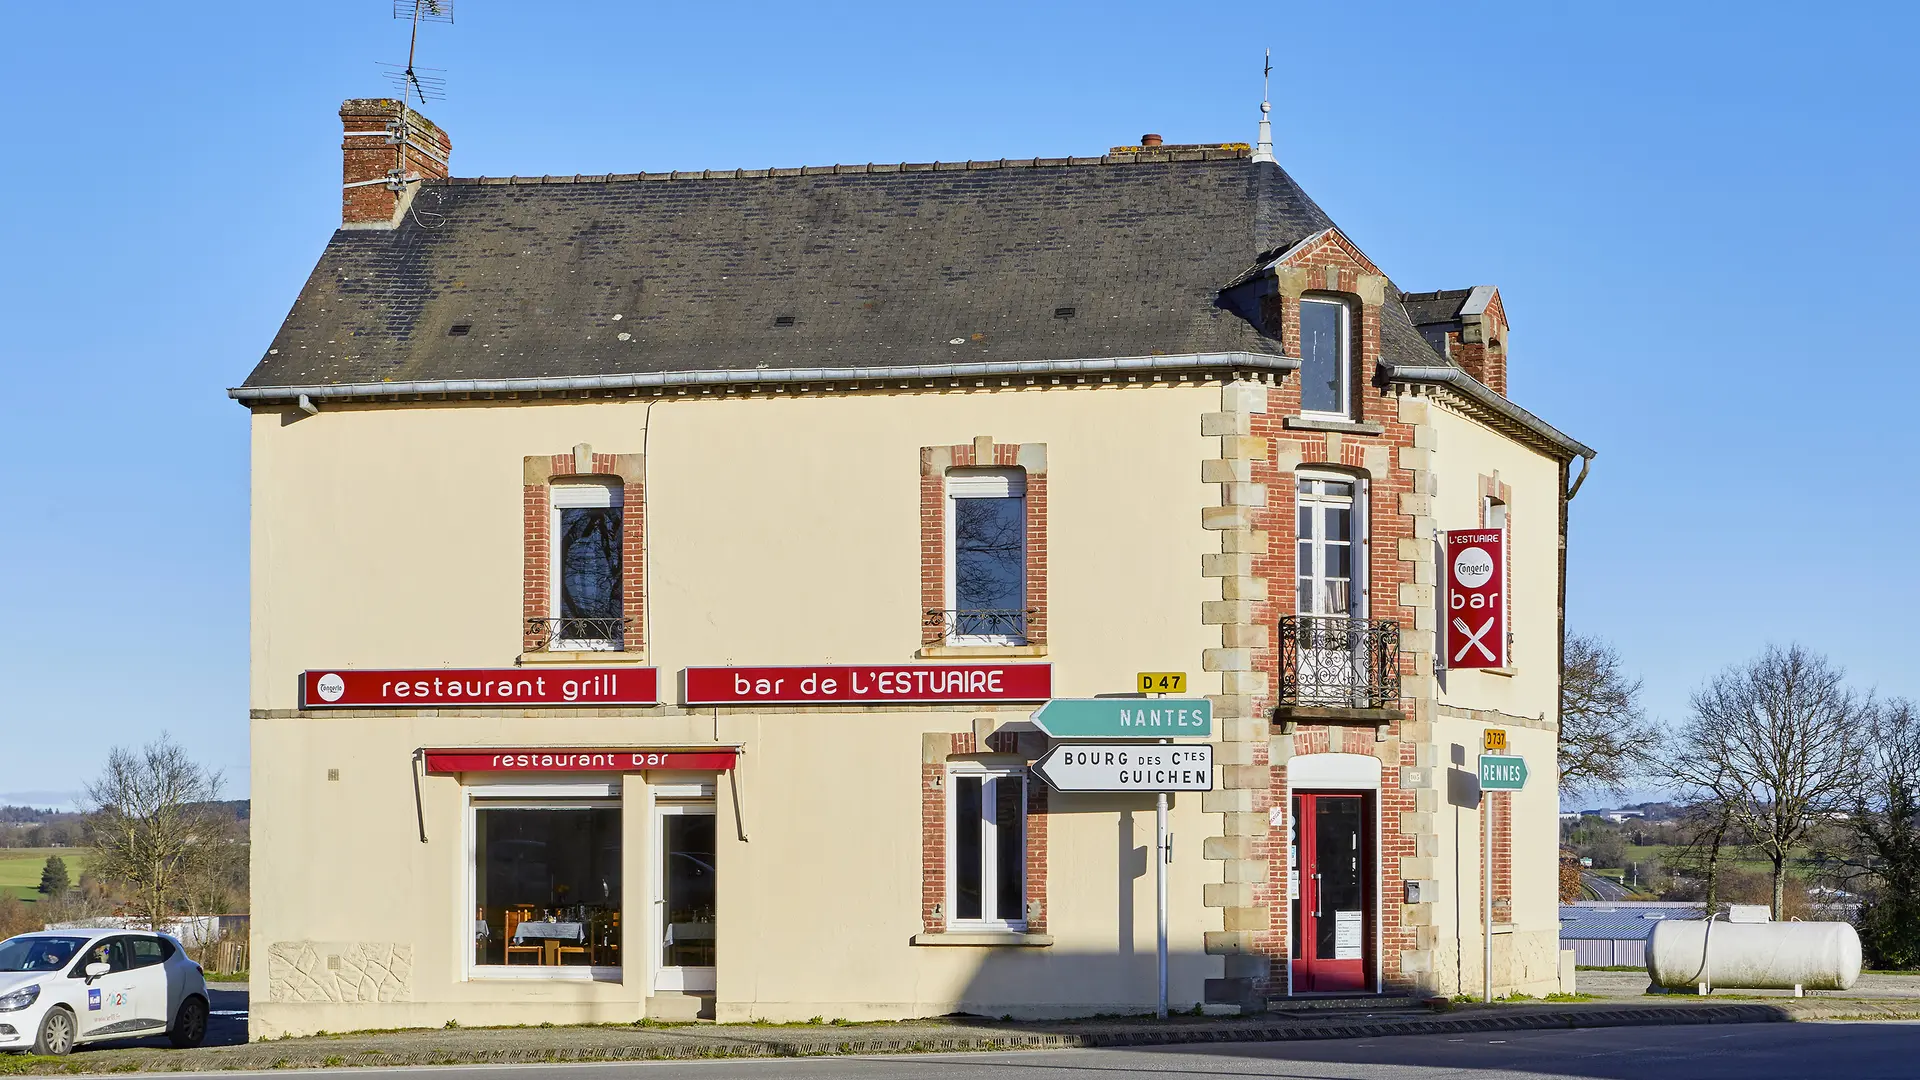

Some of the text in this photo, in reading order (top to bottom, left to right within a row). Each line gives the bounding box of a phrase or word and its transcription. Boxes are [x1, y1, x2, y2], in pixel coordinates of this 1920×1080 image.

[1449, 534, 1499, 544] L'ESTUAIRE
[1457, 562, 1490, 575] Tongerlo
[1451, 588, 1499, 610] bar
[382, 674, 617, 701] restaurant grill
[735, 670, 1004, 695] bar de L'ESTUAIRE
[1143, 676, 1181, 689] D 47
[1120, 709, 1204, 727] NANTES
[1493, 732, 1505, 745] 737
[493, 753, 669, 767] restaurant bar
[1064, 752, 1129, 766] BOURG
[1138, 756, 1162, 766] DES
[1119, 770, 1206, 784] GUICHEN
[1483, 764, 1521, 782] RENNES
